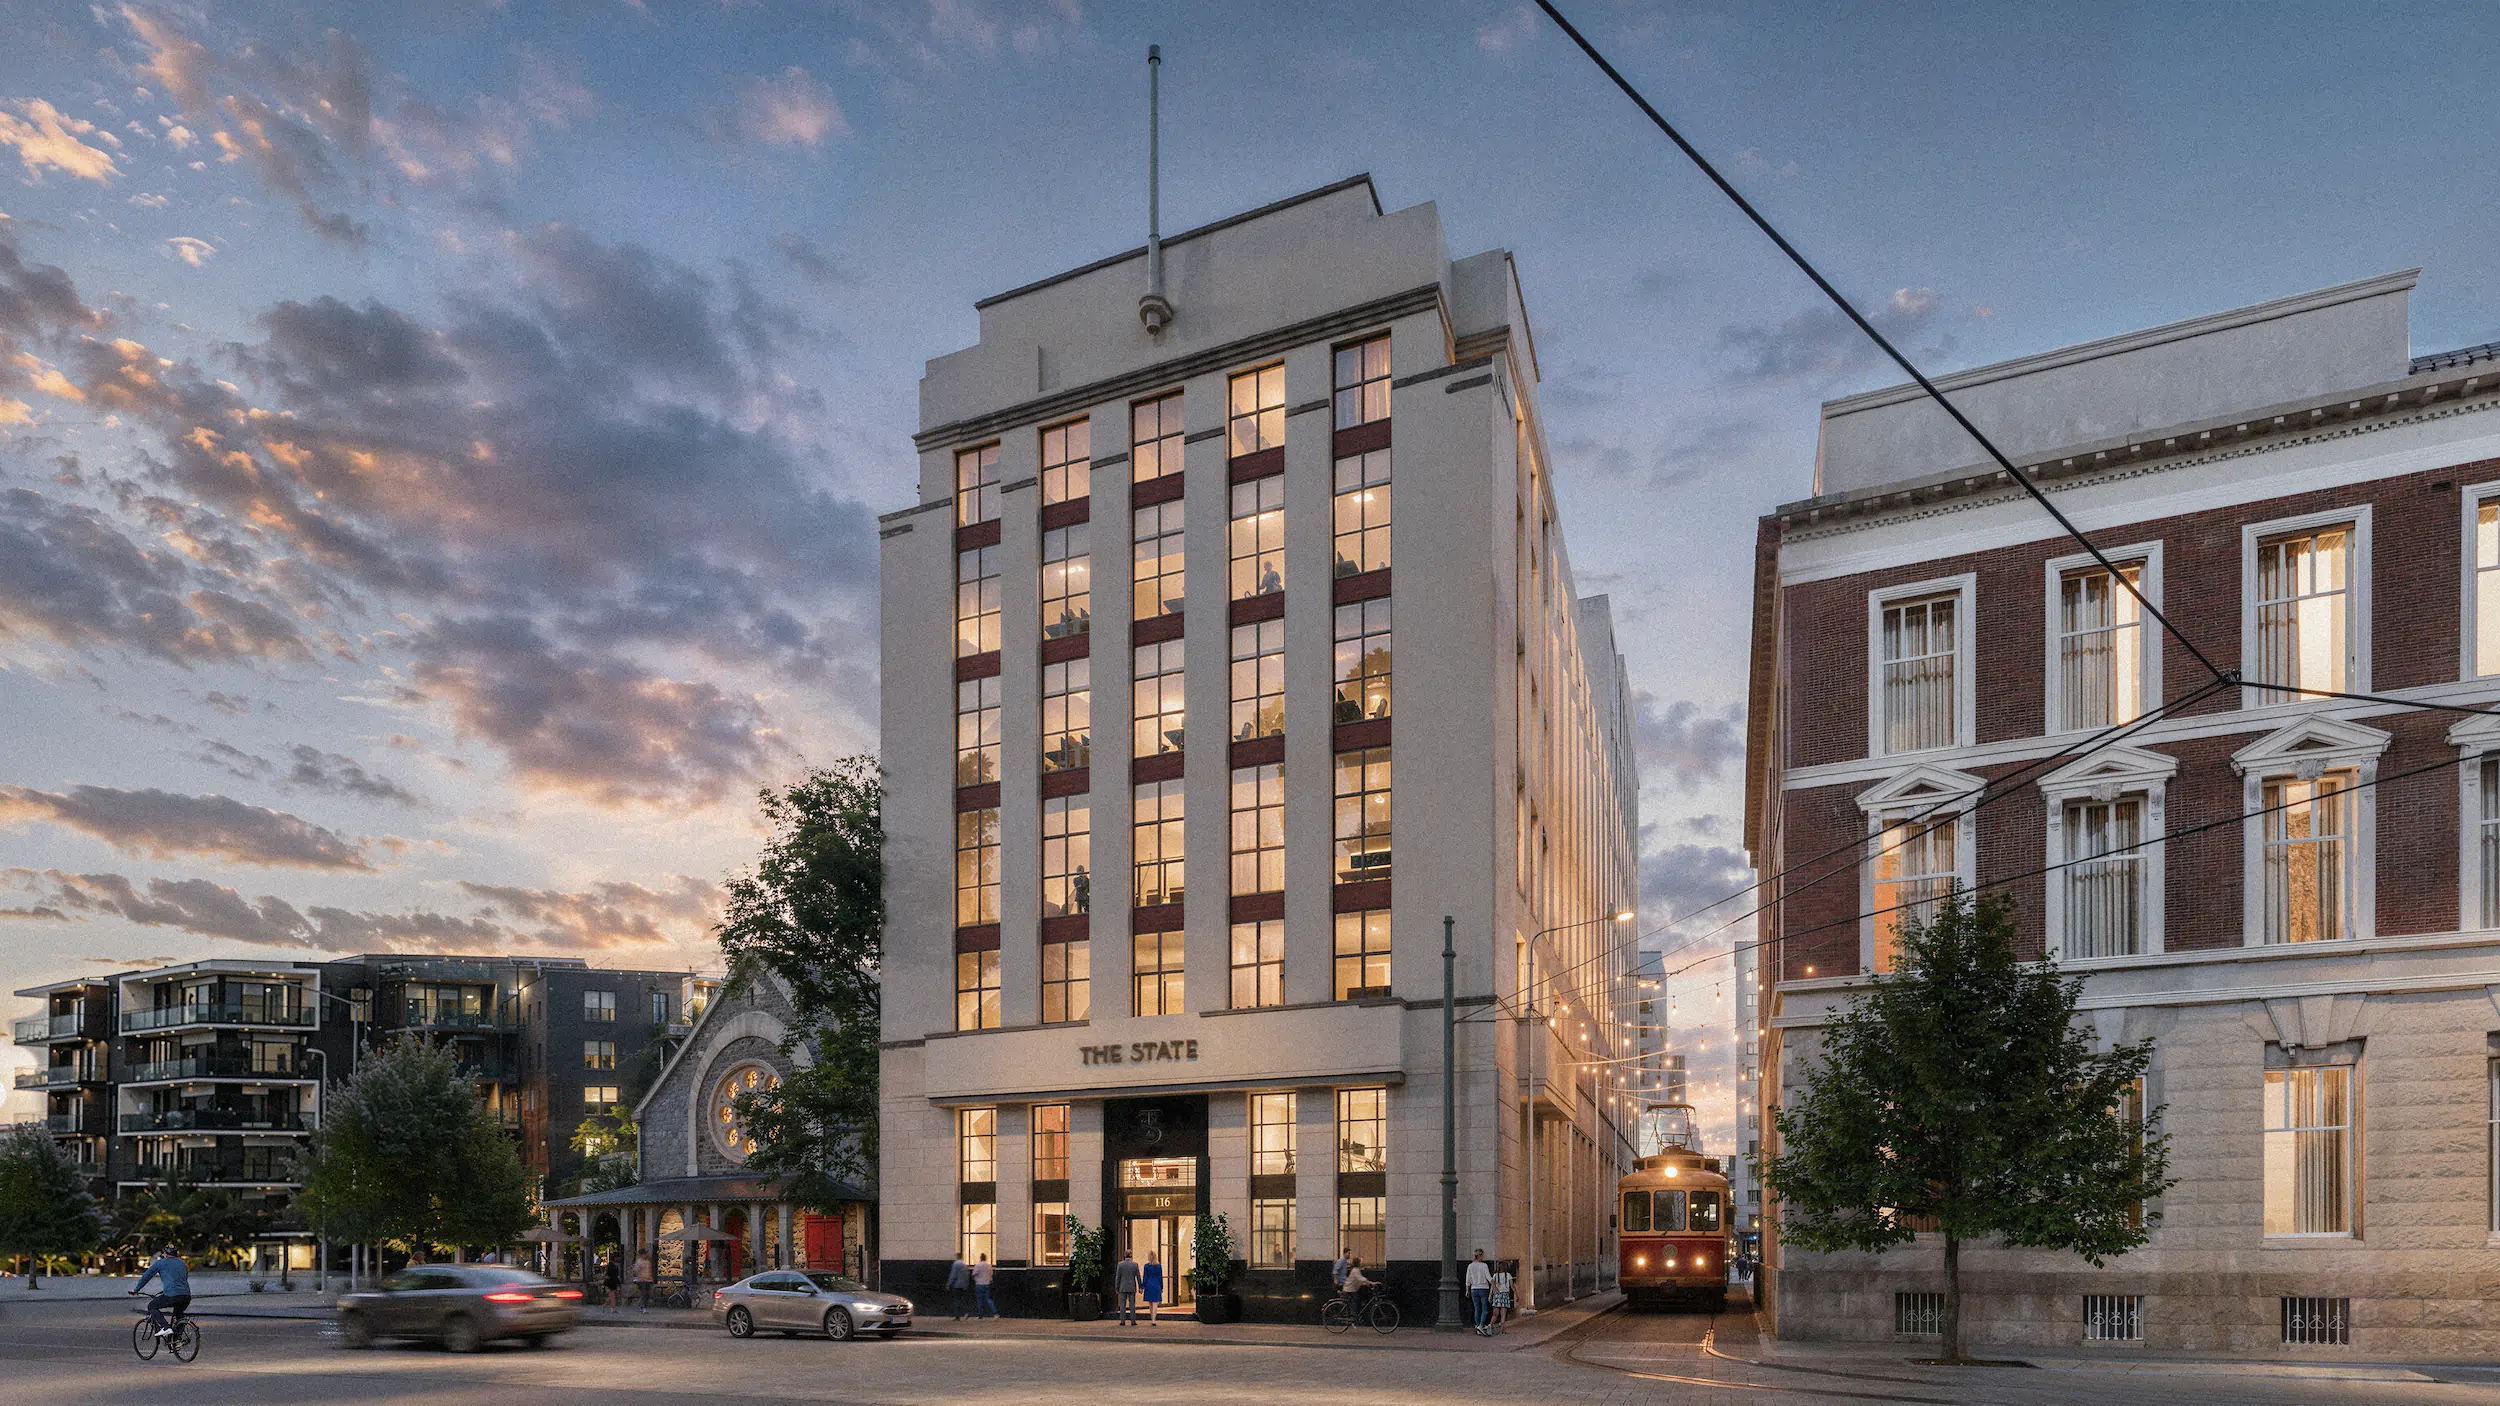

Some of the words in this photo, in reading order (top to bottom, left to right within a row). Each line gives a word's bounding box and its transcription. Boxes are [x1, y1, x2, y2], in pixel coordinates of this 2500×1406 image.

[1080, 1044, 1123, 1065] THE
[1130, 1039, 1199, 1062] STATE
[1155, 1197, 1171, 1208] 116
